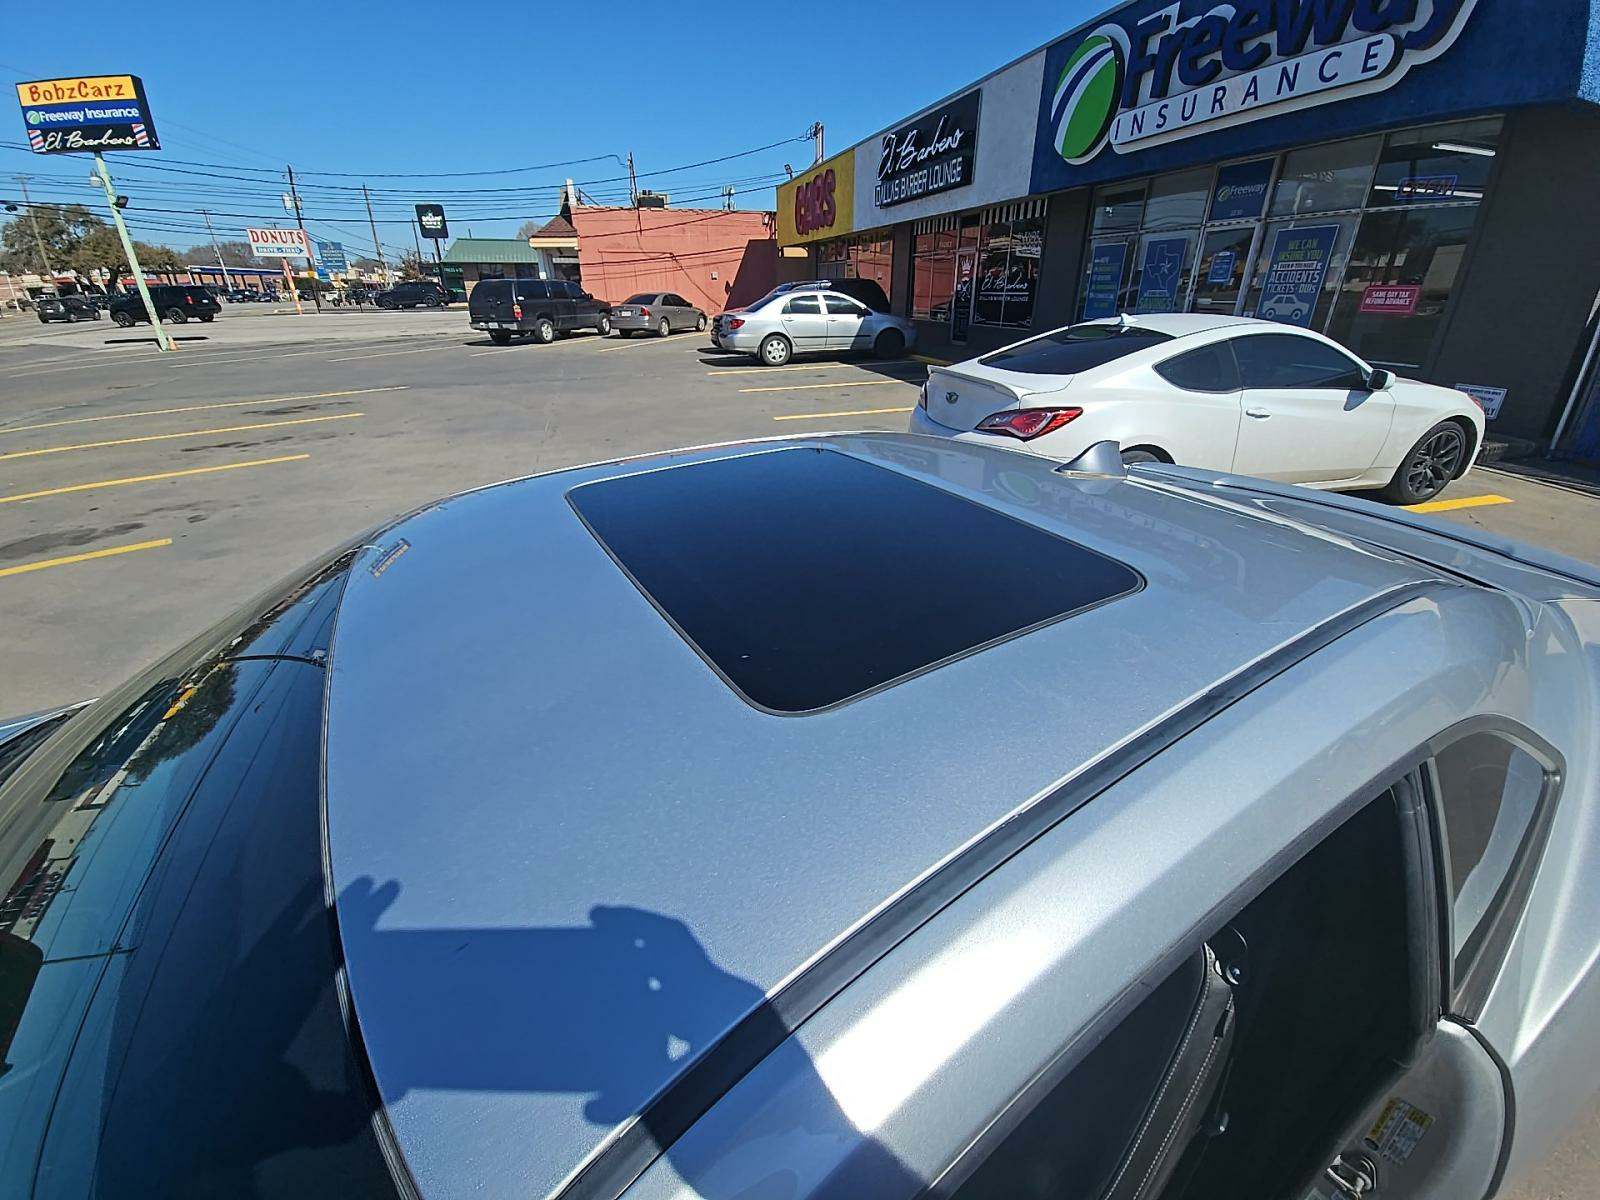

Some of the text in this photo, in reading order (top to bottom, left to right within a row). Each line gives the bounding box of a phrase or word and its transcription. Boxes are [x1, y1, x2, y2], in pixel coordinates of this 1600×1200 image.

[28, 81, 125, 102] BobzCarz
[1114, 38, 1385, 141] INSURANCE
[40, 107, 139, 122] Freeway Insurance
[875, 157, 963, 206] DALLAS BARBER LOUNGE
[1230, 184, 1266, 195] Freeway
[249, 230, 304, 244] DONUTS
[1302, 238, 1320, 249] CAN
[1268, 270, 1321, 283] ACCIDENTS
[1266, 283, 1295, 294] TICKETS
[1385, 297, 1411, 305] ADVANCE
